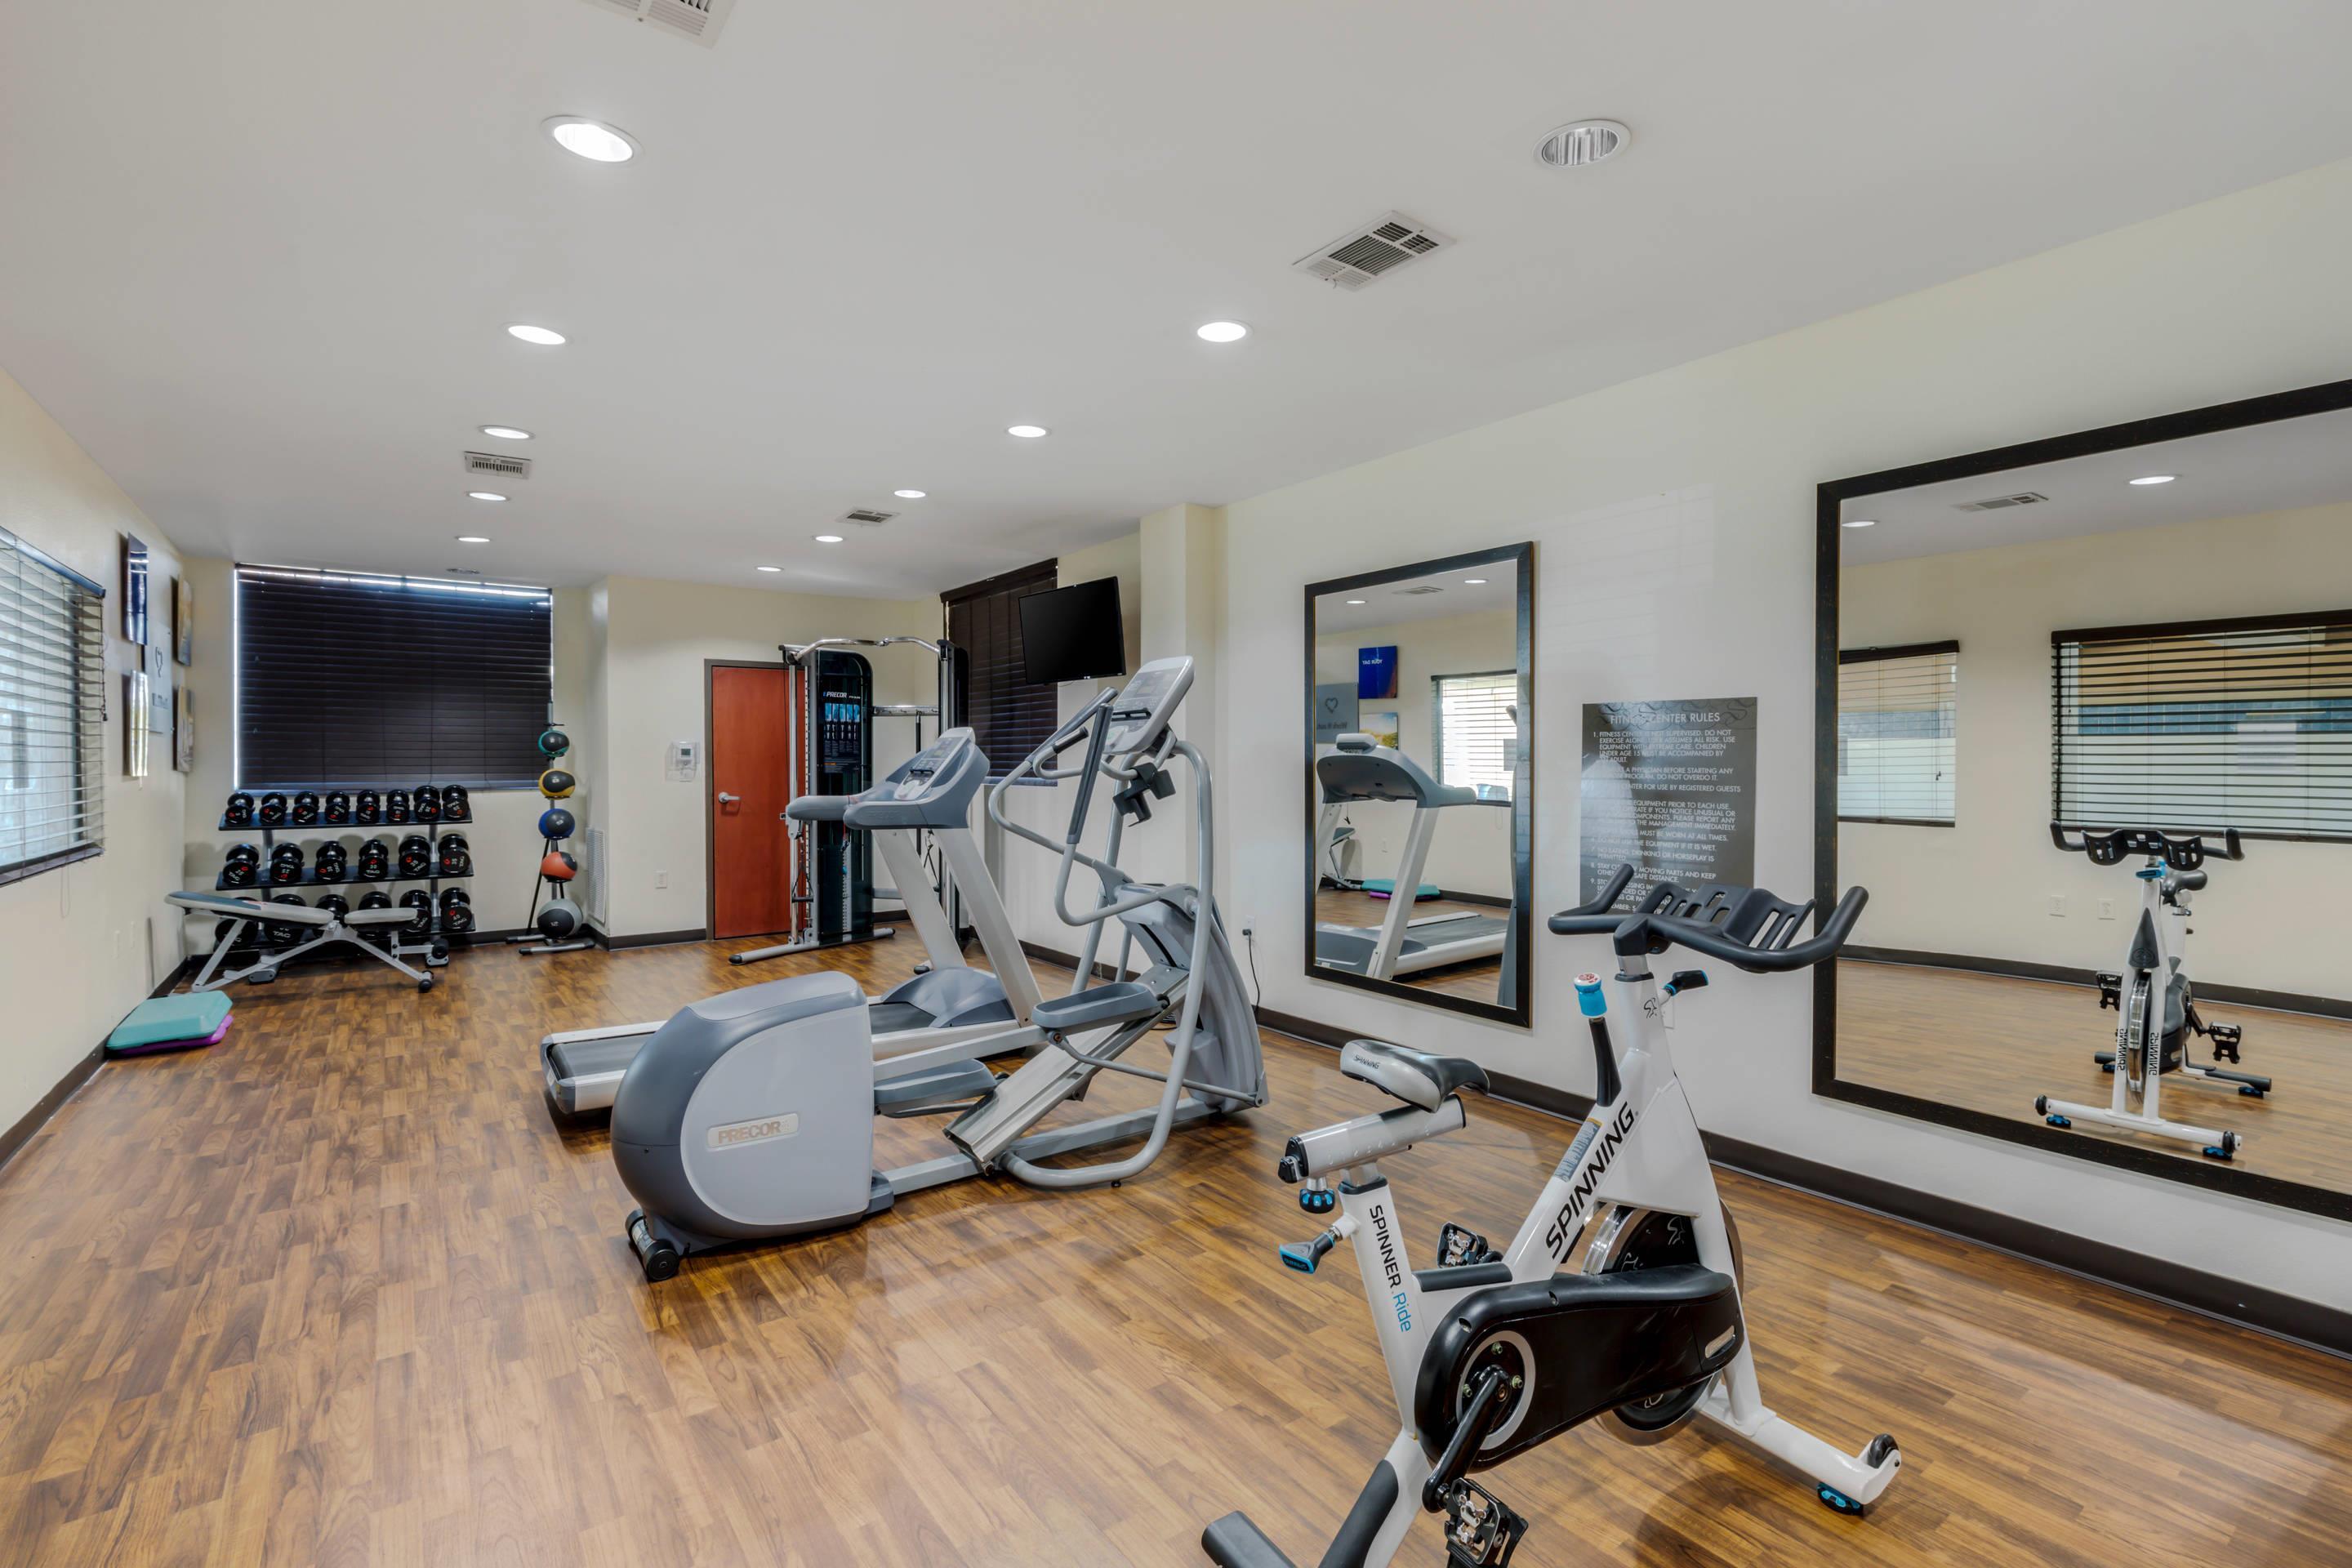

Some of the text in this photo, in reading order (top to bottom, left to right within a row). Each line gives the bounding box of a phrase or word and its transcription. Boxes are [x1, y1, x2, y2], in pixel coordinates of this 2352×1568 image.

[1610, 715, 1646, 724] FITN
[1690, 712, 1721, 723] RULES
[1668, 800, 1686, 808] PRIOR
[1629, 813, 1672, 821] OMPONENTS.
[1648, 819, 1692, 828] MANAGEMENT
[228, 871, 241, 882] TAG
[1639, 866, 1665, 875] MOVING
[1666, 868, 1684, 877] PARTS
[1685, 871, 1699, 879] AND
[1701, 872, 1717, 880] KEEP
[452, 917, 467, 927] TAG
[273, 930, 292, 938] TAG
[718, 1120, 782, 1145] PRECOR
[1545, 1102, 1635, 1258] SPINNING
[1370, 1205, 1412, 1333] SPINNER Ride
